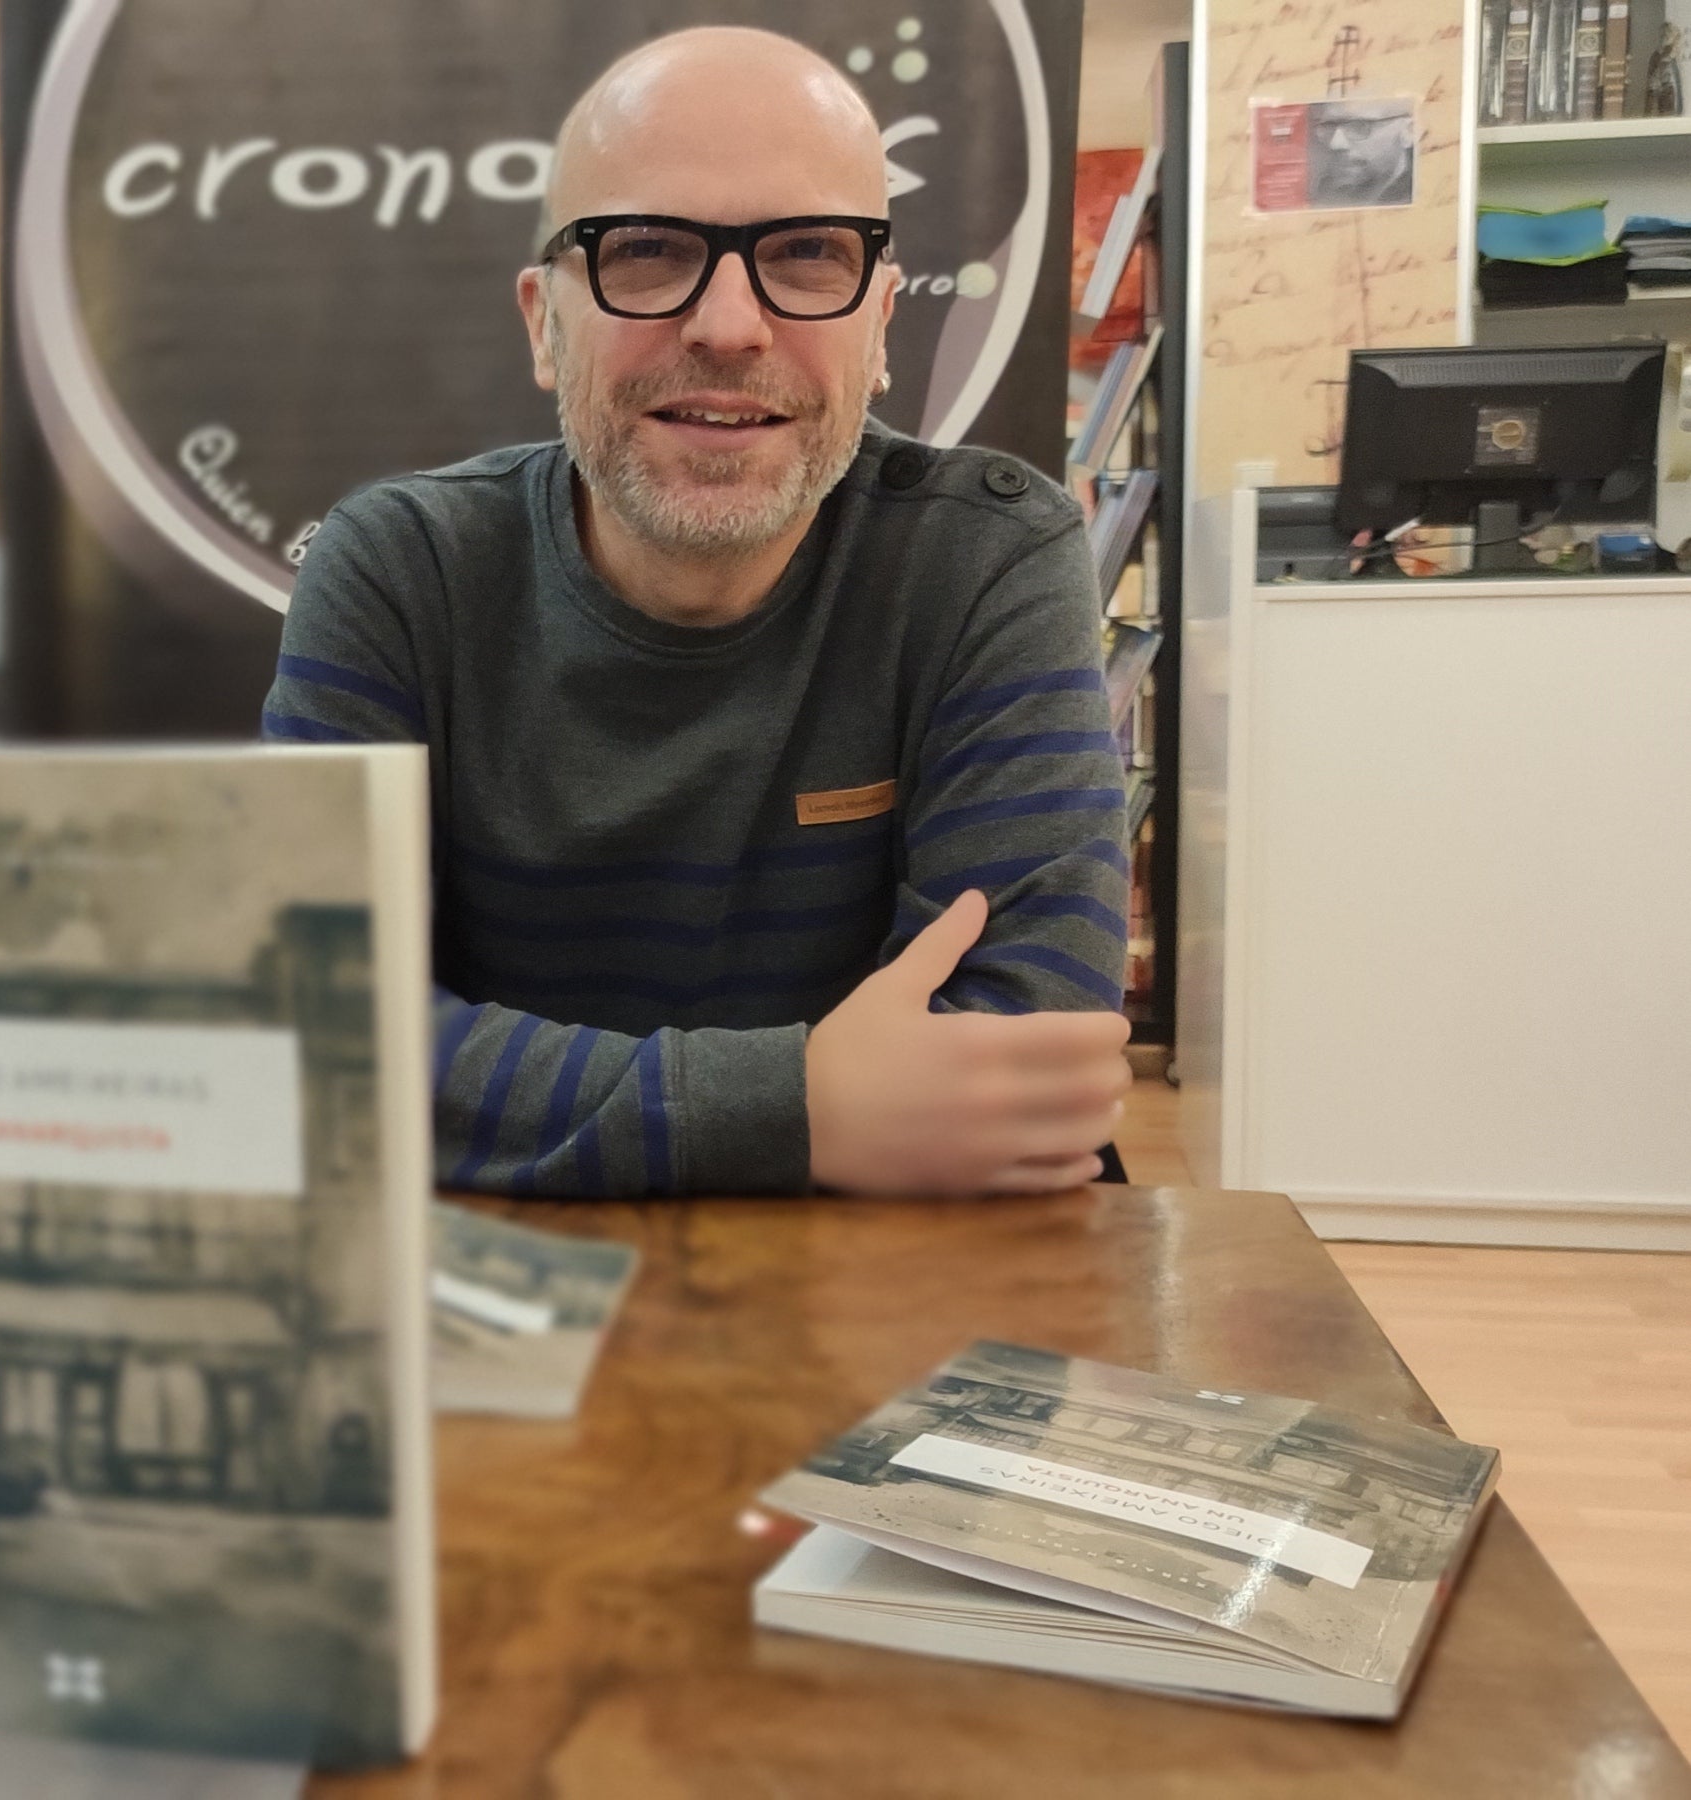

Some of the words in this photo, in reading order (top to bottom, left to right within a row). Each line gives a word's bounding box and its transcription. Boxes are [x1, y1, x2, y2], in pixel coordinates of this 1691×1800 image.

[976, 1465, 1172, 1517] AMEIXEIRAS
[1024, 1463, 1198, 1510] ANARQUISTA
[1176, 1514, 1276, 1548] DIEGO
[1201, 1507, 1245, 1525] UN
